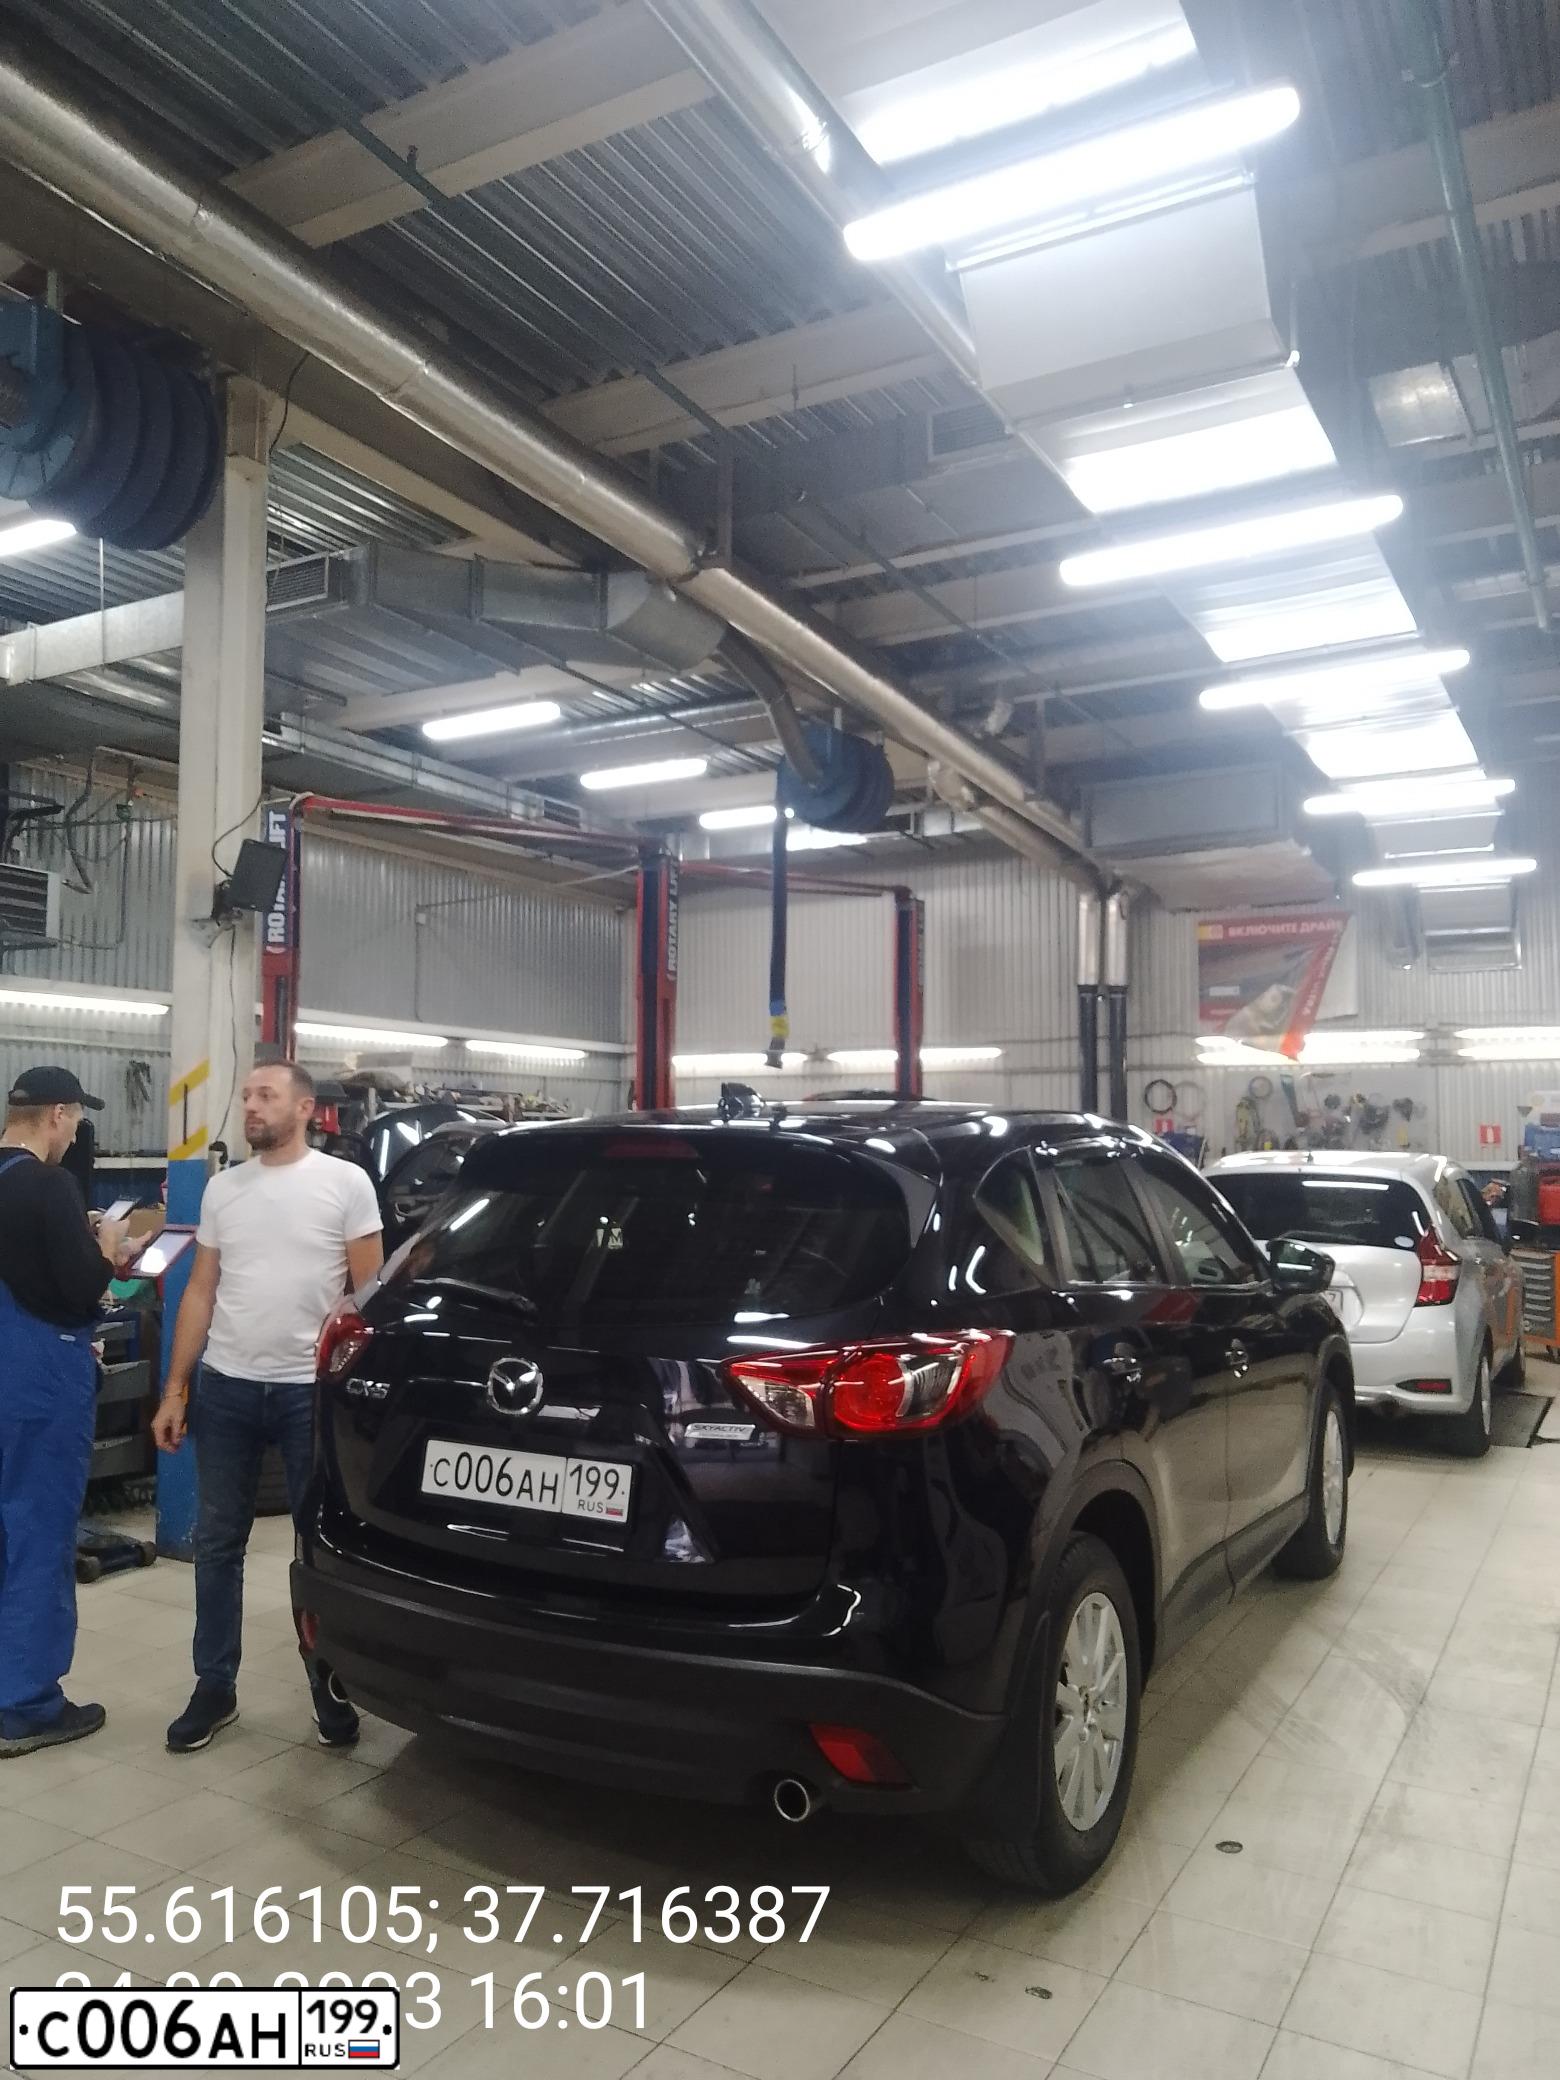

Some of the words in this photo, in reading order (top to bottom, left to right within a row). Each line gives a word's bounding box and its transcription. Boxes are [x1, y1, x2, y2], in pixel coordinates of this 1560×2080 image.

[693, 1424, 747, 1432] SKYACTIV
[569, 1463, 620, 1500] 199
[577, 1499, 604, 1514] RUS
